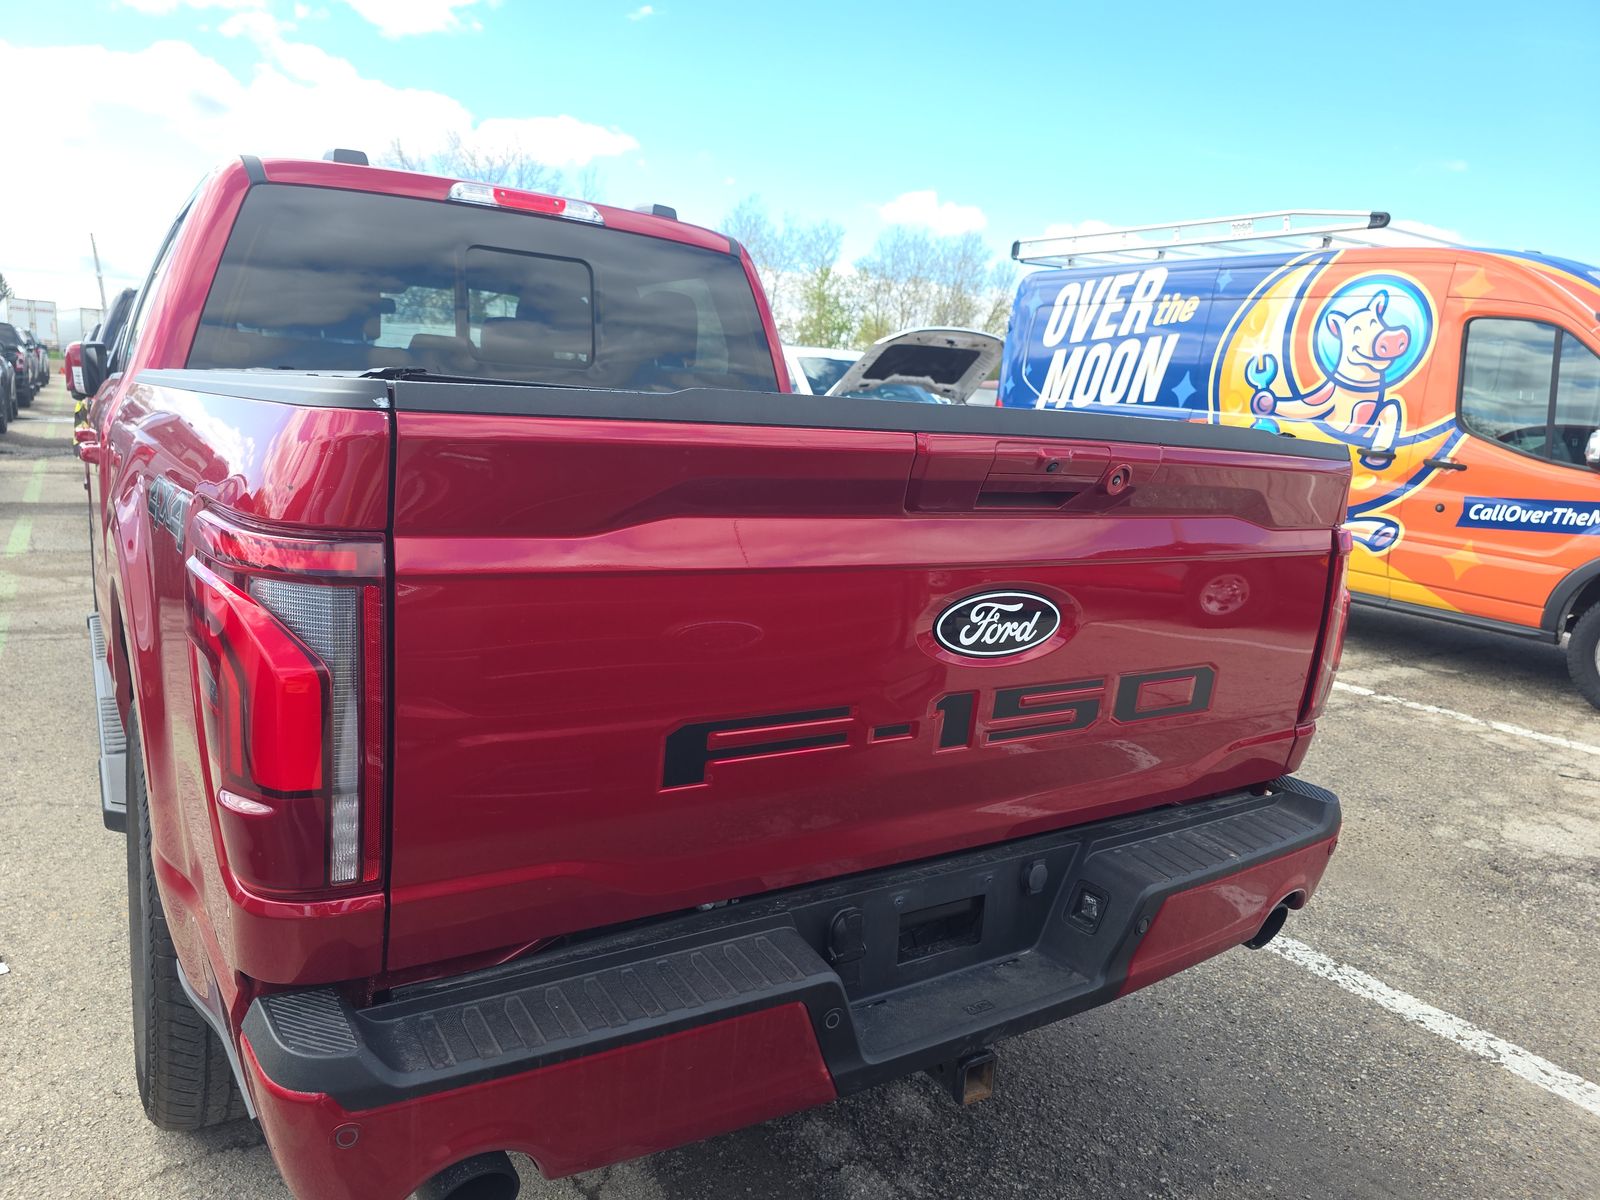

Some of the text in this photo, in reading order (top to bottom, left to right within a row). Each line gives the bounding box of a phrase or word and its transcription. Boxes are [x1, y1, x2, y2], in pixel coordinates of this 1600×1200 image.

[1043, 267, 1200, 348] OVER the
[1035, 333, 1181, 409] MOON
[959, 602, 1041, 646] Ford
[660, 665, 1217, 790] F-150
